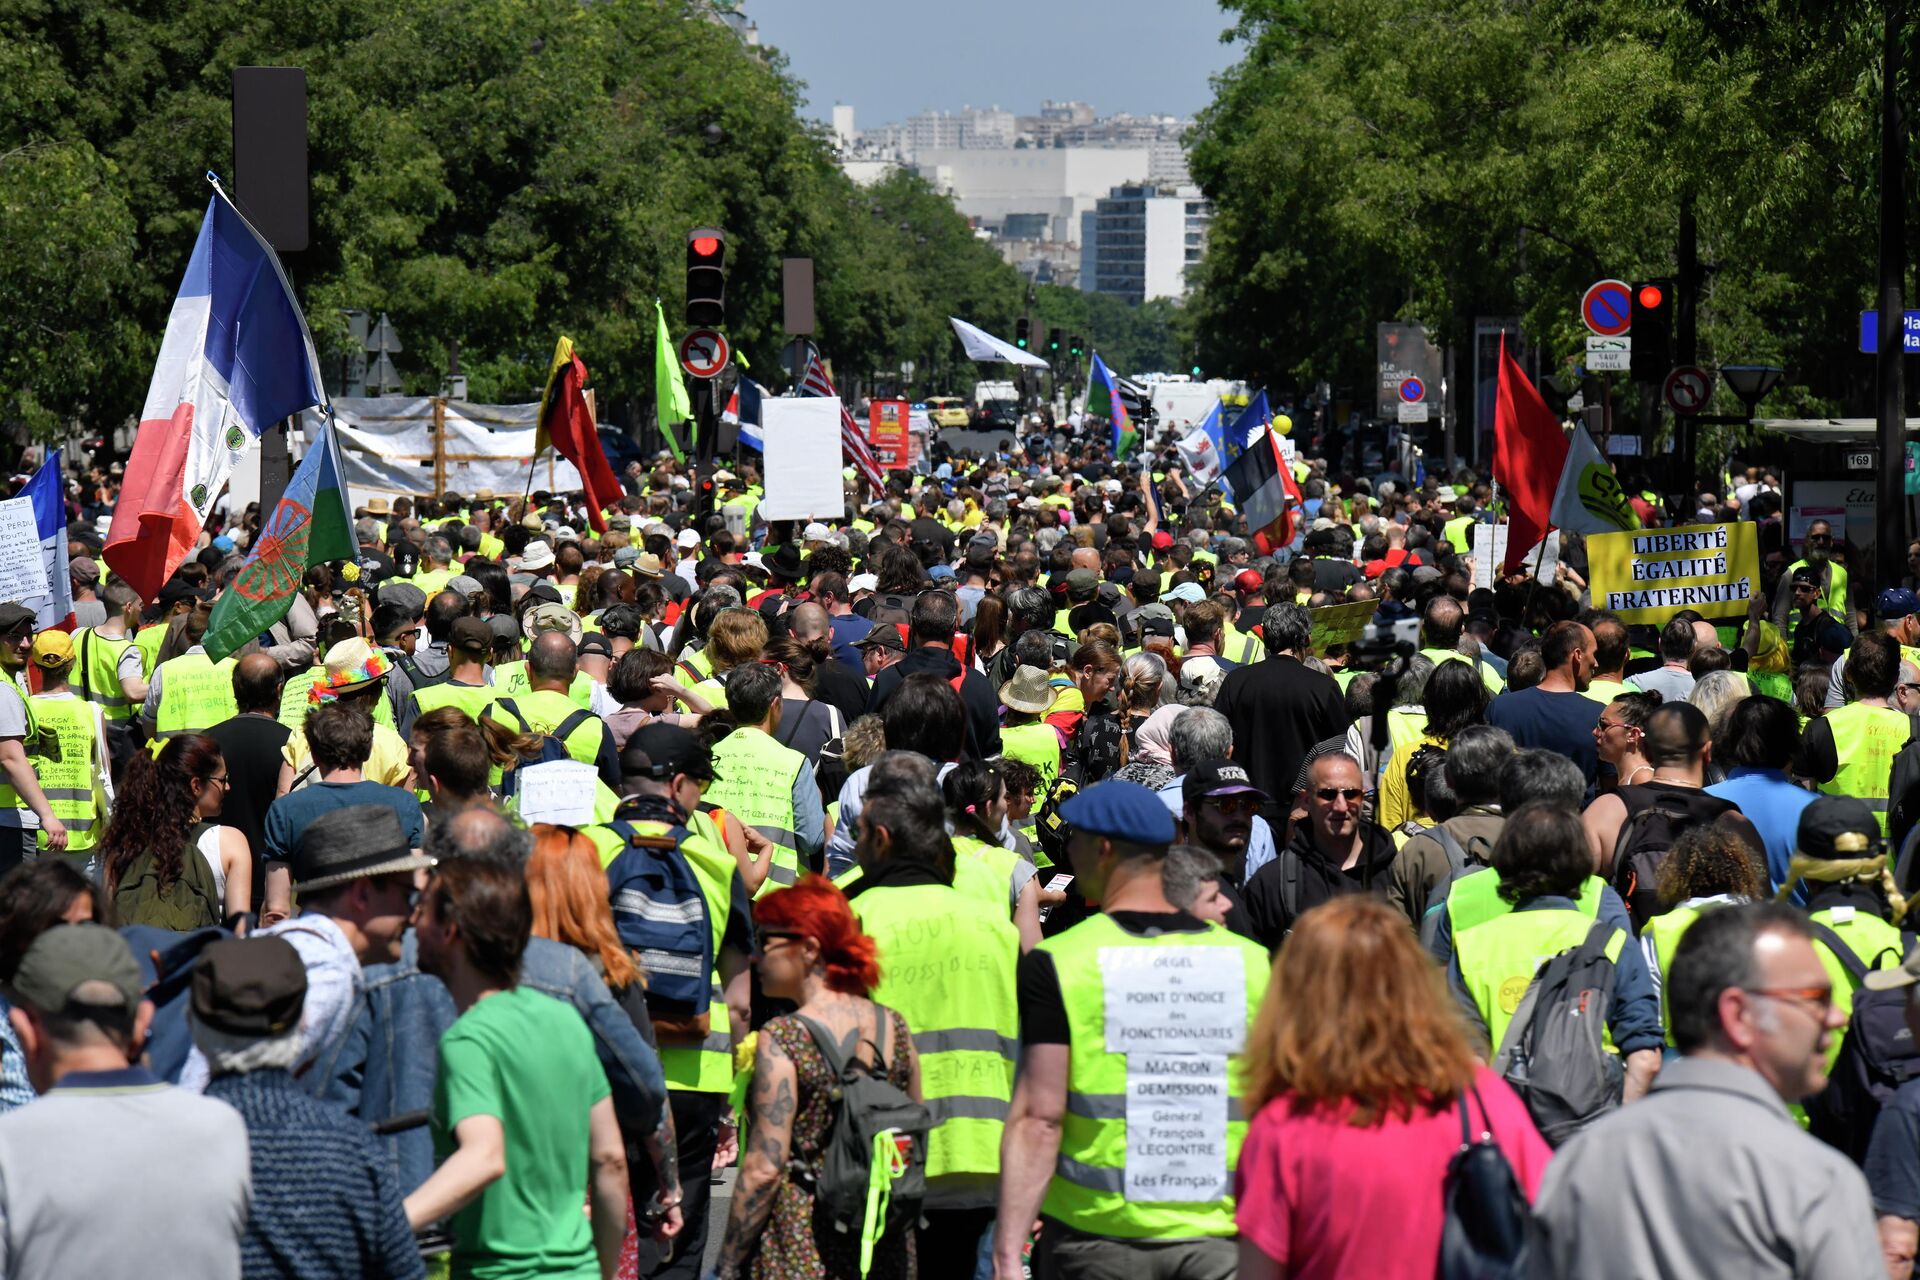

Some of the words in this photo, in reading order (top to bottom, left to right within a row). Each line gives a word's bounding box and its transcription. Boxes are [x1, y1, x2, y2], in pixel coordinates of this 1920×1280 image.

[1599, 353, 1618, 361] SAUF
[1851, 455, 1869, 465] 169
[6, 519, 34, 531] PERDU
[1632, 526, 1727, 554] LIBERTÉ
[1632, 553, 1726, 580] ÉGALITÉ
[1609, 577, 1750, 610] FRATERNITÉ
[508, 673, 525, 694] Je
[889, 912, 956, 947] TOUT
[889, 954, 989, 988] POSSIBLE
[1169, 976, 1182, 985] du
[1126, 992, 1166, 1003] POINT
[1170, 991, 1225, 1003] D'INDICE
[1169, 1011, 1186, 1020] des
[1120, 1028, 1233, 1039] FONCTIONNAIRES
[1144, 1061, 1211, 1074] MACRON
[1137, 1083, 1218, 1096] DEMISSION
[1152, 1110, 1203, 1122] Général
[1150, 1127, 1205, 1140] François
[1137, 1144, 1215, 1156] LECOINTRE
[1134, 1174, 1156, 1187] Les
[1161, 1173, 1218, 1188] Français
